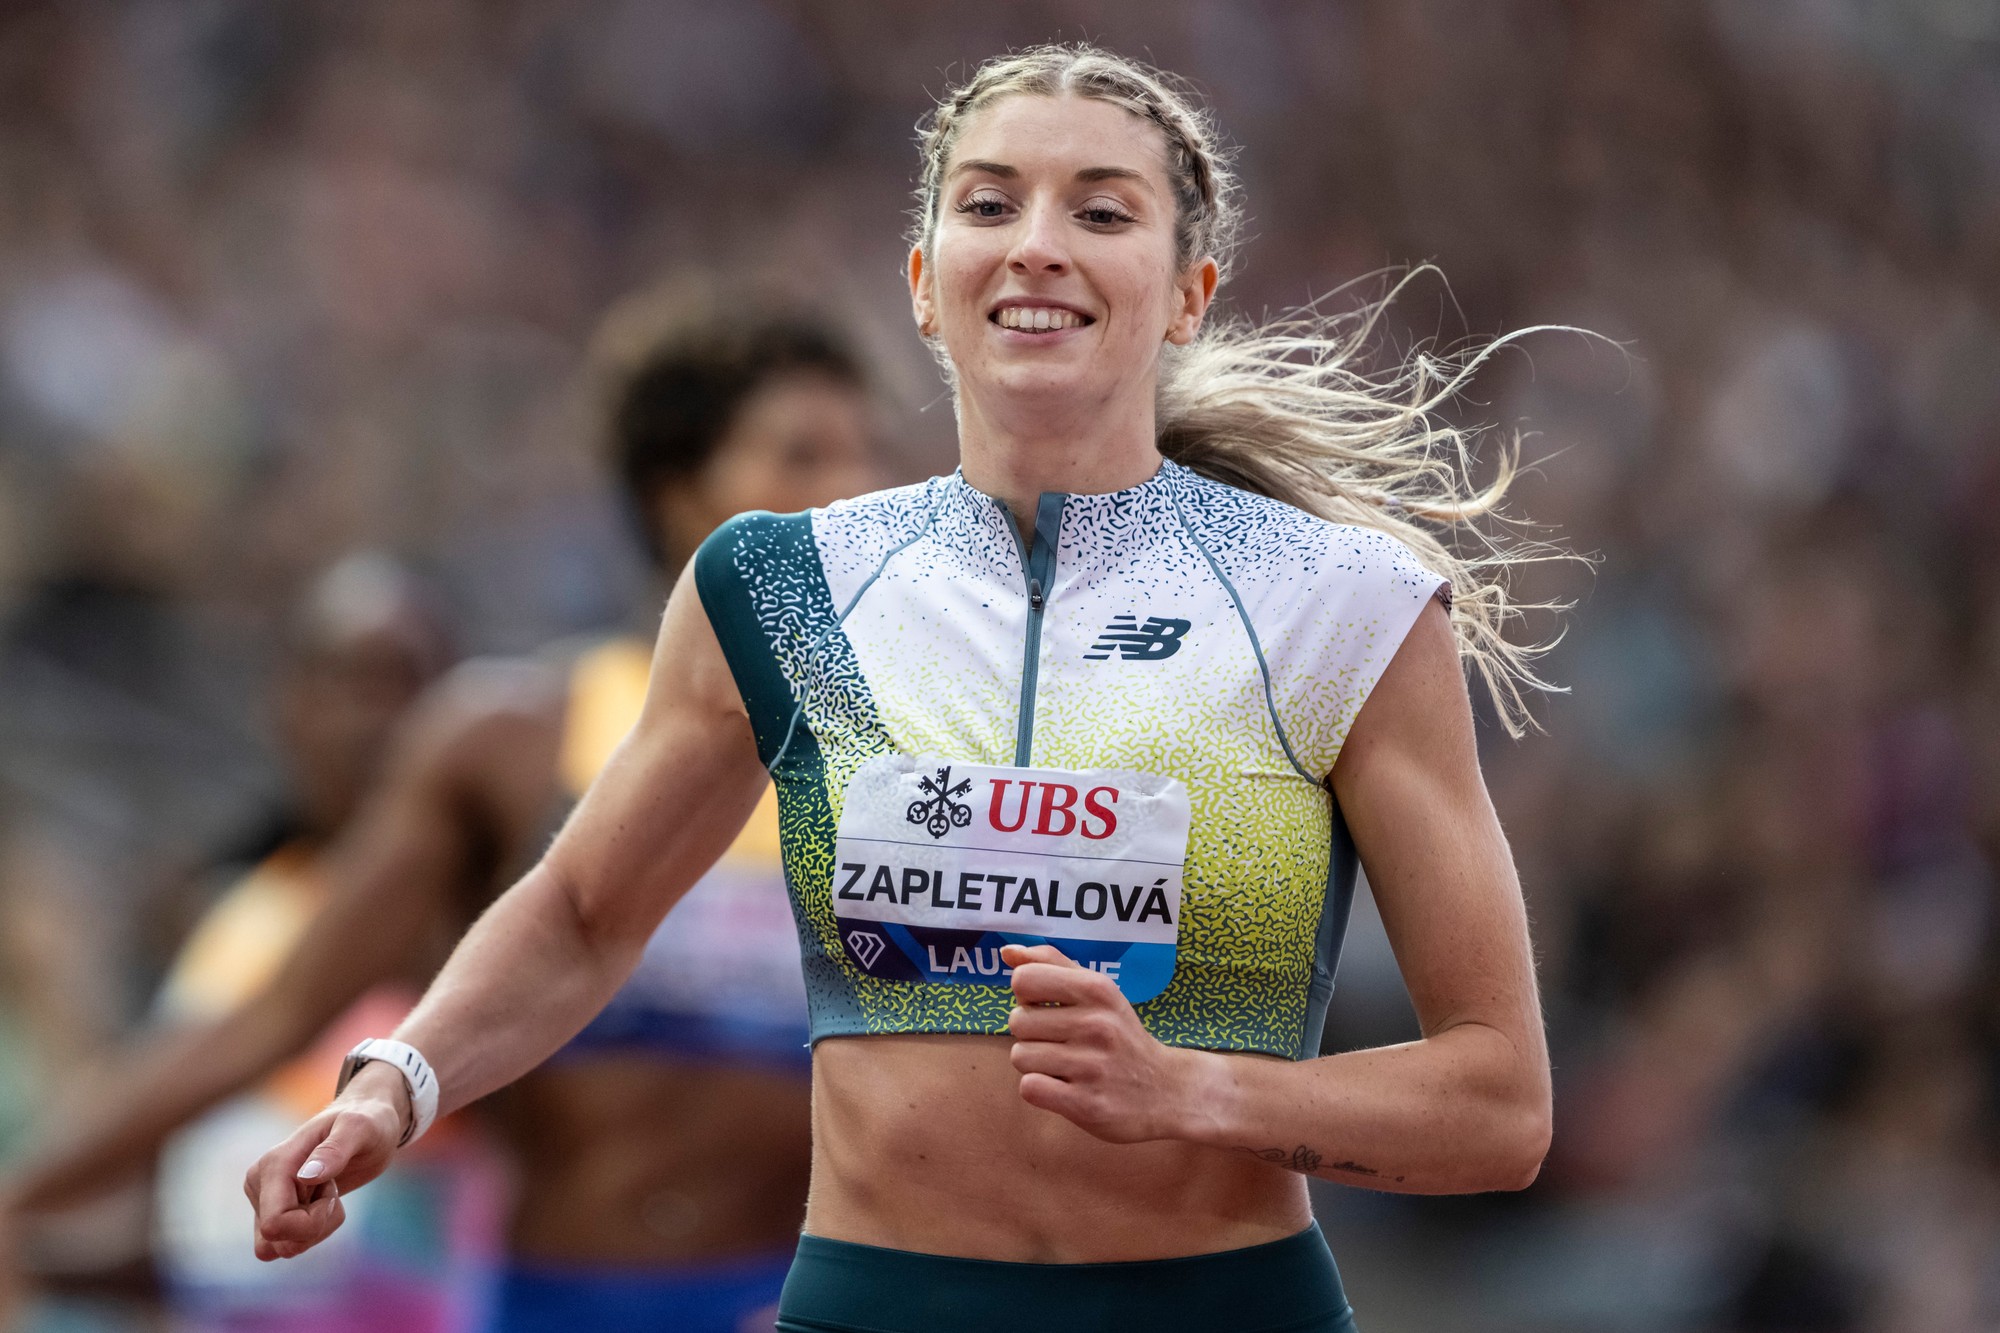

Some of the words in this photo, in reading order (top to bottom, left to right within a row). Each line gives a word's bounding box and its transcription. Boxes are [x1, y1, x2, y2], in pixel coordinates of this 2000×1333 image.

[988, 778, 1120, 839] UBS
[838, 862, 1173, 925] ZAPLETALOVÁ
[928, 945, 1122, 990] LAUE
